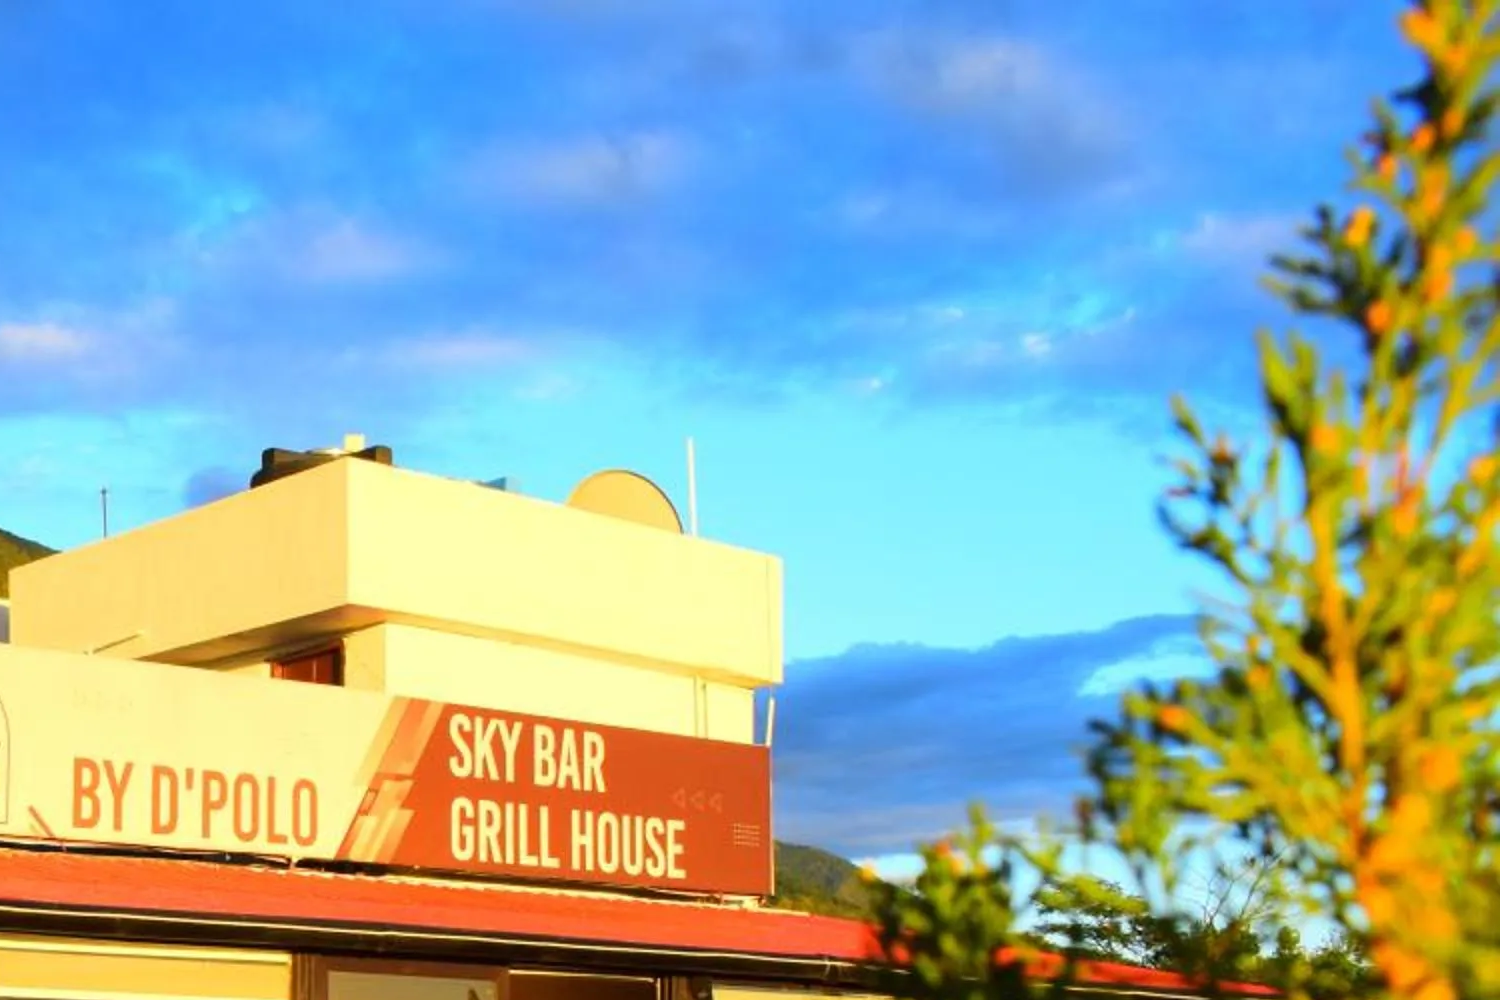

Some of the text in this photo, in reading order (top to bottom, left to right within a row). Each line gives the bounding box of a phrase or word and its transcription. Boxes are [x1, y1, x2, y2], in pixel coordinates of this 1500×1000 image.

[449, 713, 606, 793] SKY BAR
[72, 757, 319, 847] BY D'POLO
[451, 796, 687, 880] GRILL HOUSE
